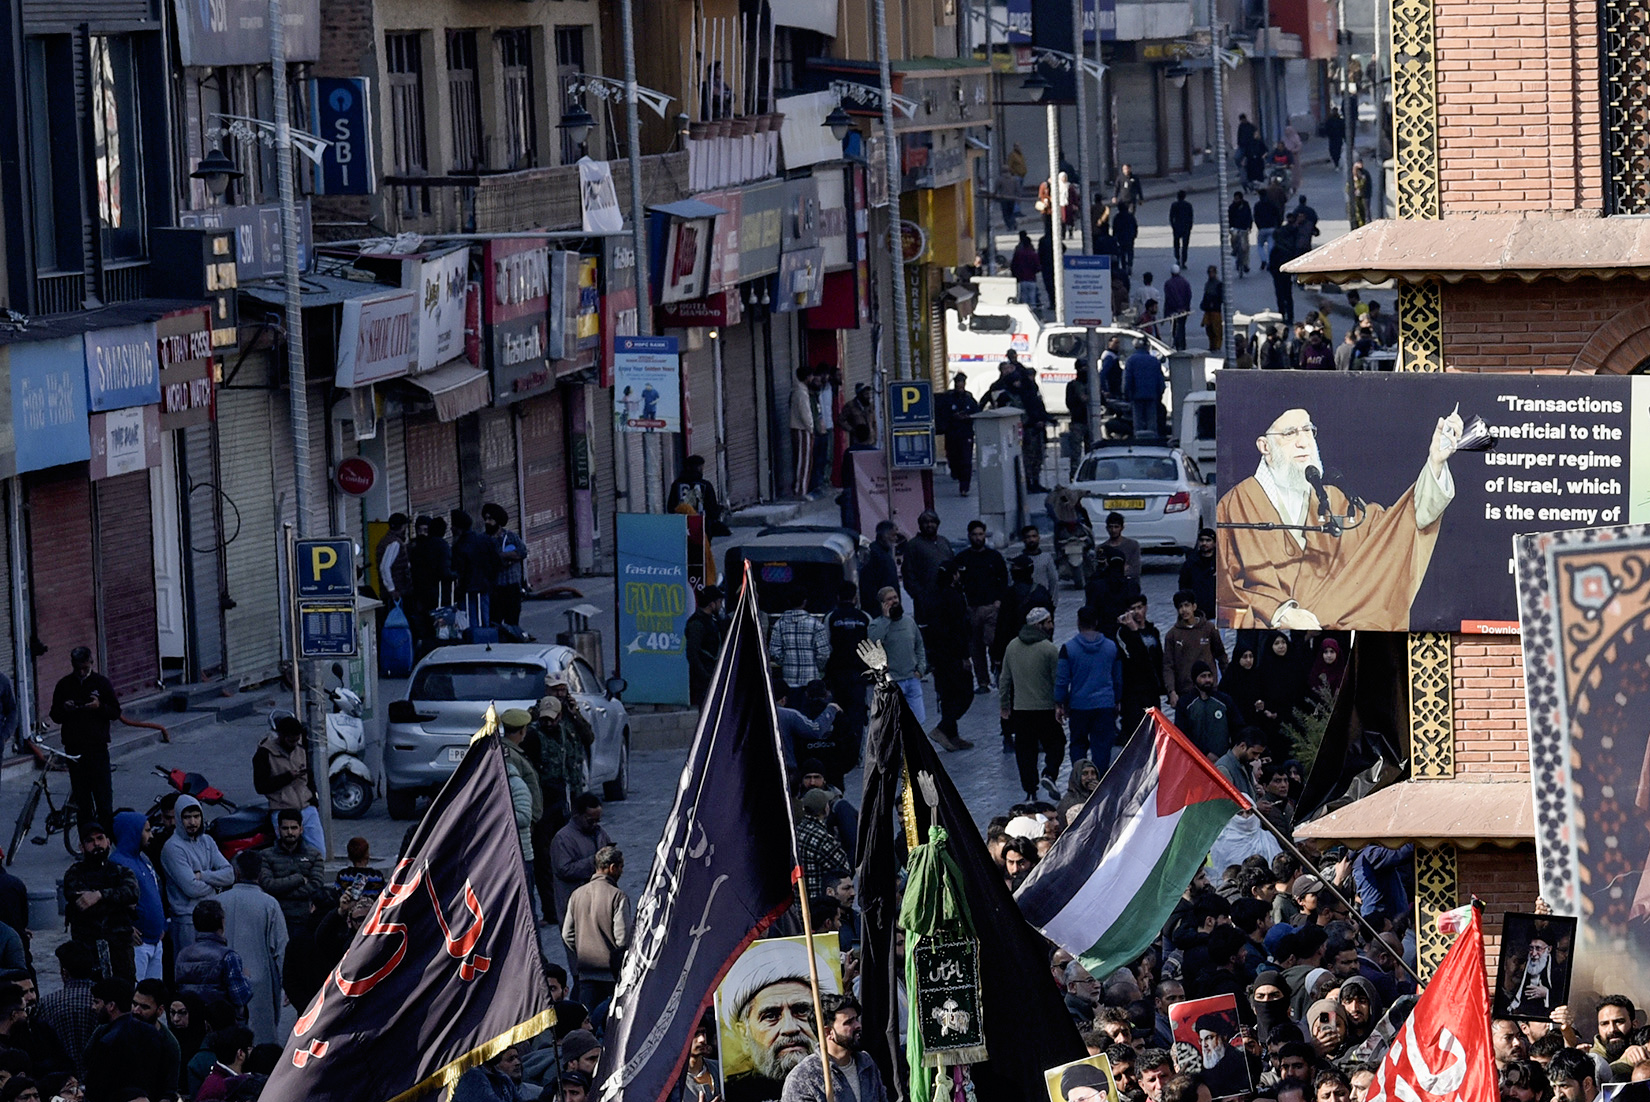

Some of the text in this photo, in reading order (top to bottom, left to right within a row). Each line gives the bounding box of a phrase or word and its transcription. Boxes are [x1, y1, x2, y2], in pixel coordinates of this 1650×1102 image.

[335, 119, 353, 187] SBI
[680, 308, 721, 317] DIAMOND
[97, 341, 153, 392] SAMSUNG
[166, 378, 211, 414] WORLD WATCH
[902, 387, 920, 413] P
[1570, 425, 1588, 439] to
[1592, 424, 1622, 440] the
[1485, 451, 1621, 470] usurper regime
[1485, 477, 1621, 495] of Israel, which
[1486, 503, 1620, 525] is the enemy of
[312, 546, 338, 581] P
[625, 563, 682, 576] fastrack
[625, 582, 685, 617] FOMO
[646, 632, 681, 650] 40%
